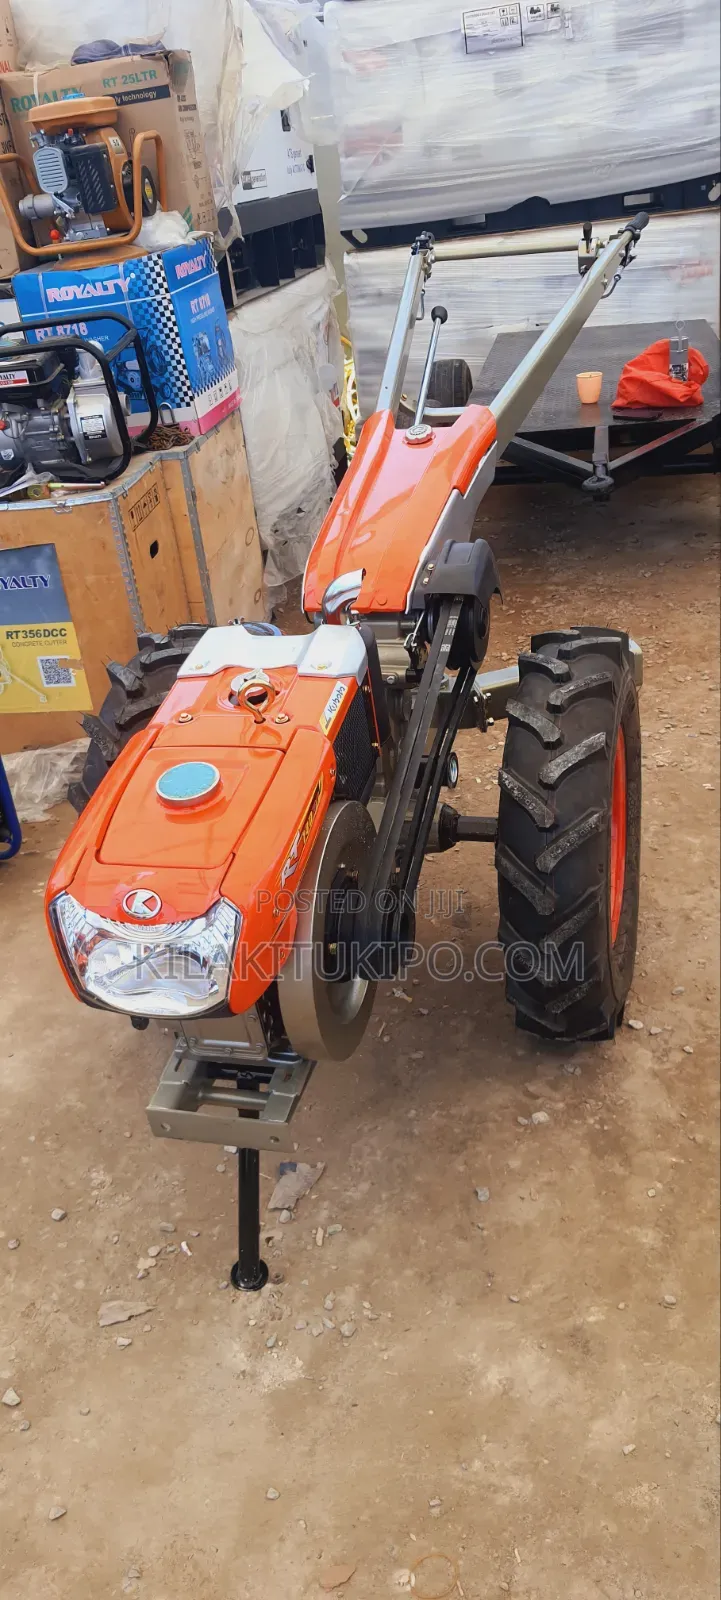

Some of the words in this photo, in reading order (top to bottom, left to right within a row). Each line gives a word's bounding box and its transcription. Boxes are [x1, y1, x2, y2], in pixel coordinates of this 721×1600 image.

[102, 76, 117, 88] RT
[121, 69, 157, 85] 25LTR
[122, 91, 157, 102] technology
[175, 253, 208, 280] ROYALTY
[46, 277, 131, 302] ROYALTY
[34, 326, 53, 342] RT
[0, 574, 50, 590] YALTY
[6, 628, 68, 640] RT356DCC
[327, 686, 346, 714] Kubota
